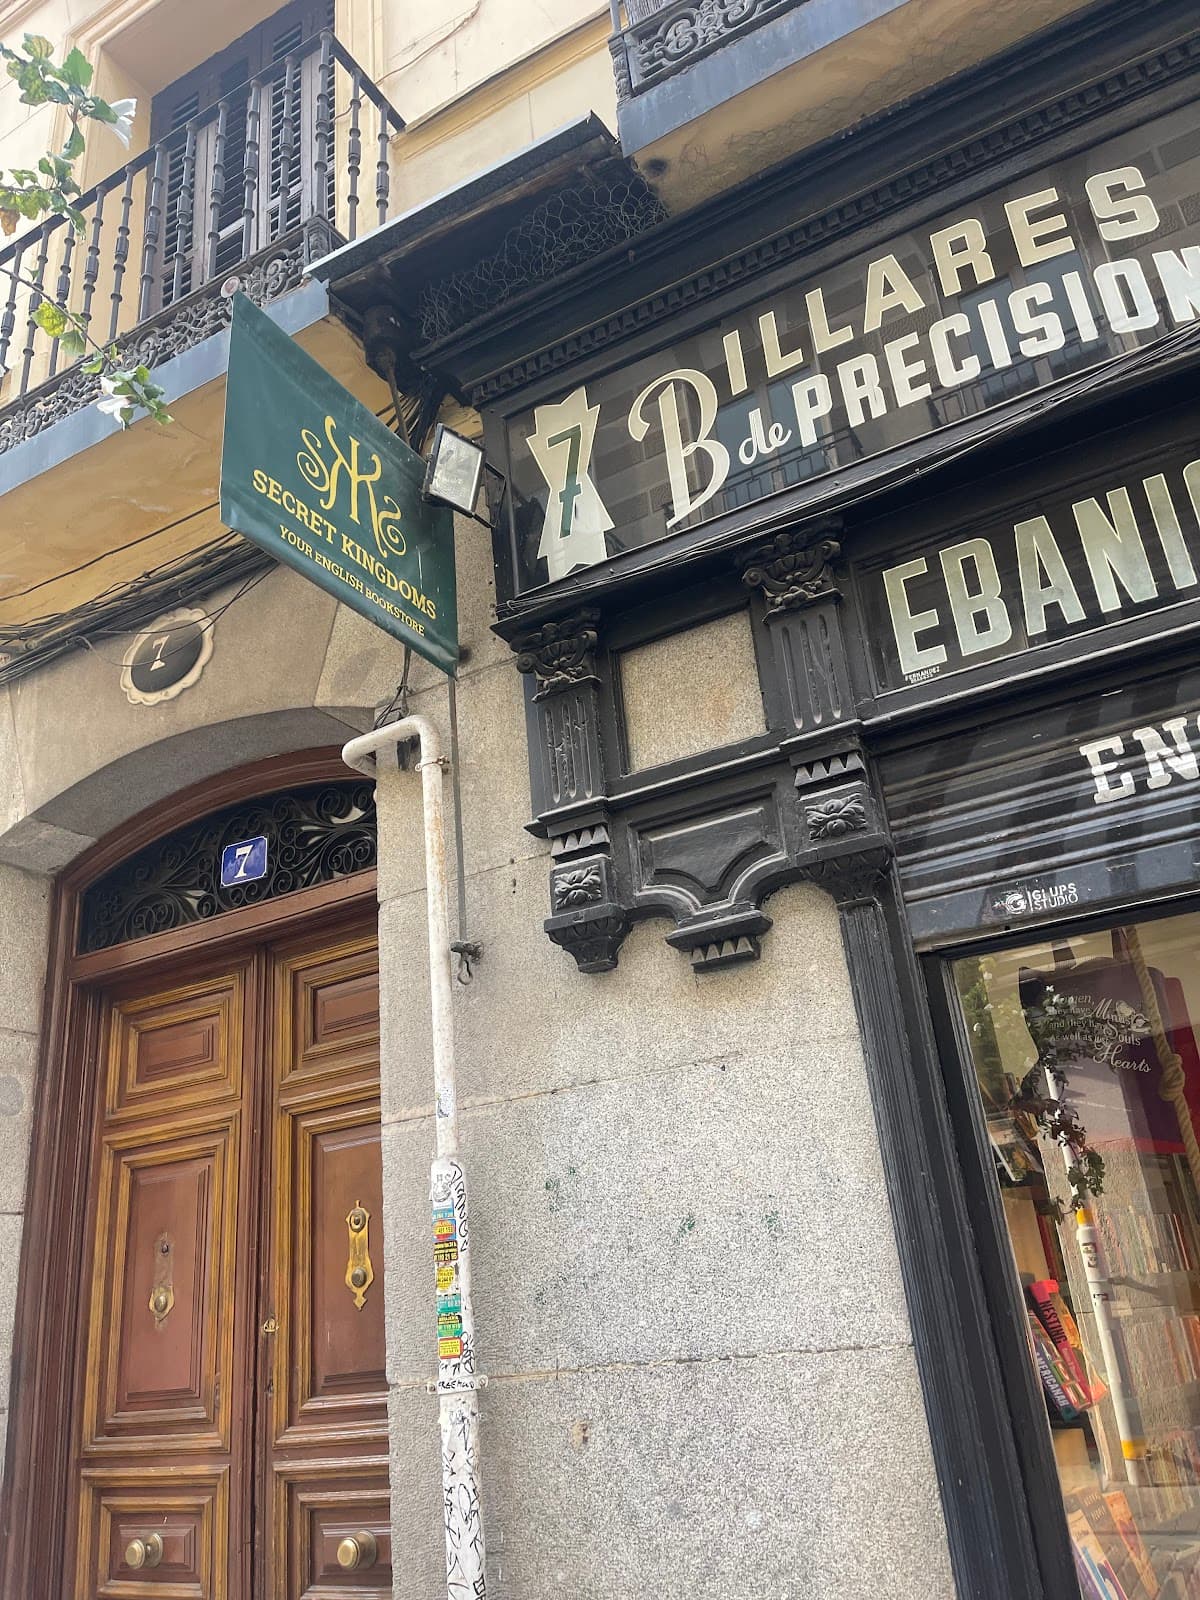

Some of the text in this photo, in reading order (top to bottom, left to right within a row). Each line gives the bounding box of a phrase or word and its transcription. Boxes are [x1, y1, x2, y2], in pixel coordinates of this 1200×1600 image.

[627, 166, 1161, 529] BILLARES
[738, 246, 1200, 465] de PRECISION
[546, 422, 582, 539] 7
[252, 469, 437, 620] SECRET KINGDOMS
[279, 524, 425, 637] YOUR ENGLISH BOOKSTORE
[882, 459, 1200, 675] EBANI
[150, 634, 171, 672] 7
[233, 844, 254, 880] 7
[1034, 893, 1079, 911] STUDIO
[1093, 1042, 1152, 1073] Hearts
[1039, 1300, 1068, 1345] NESTING
